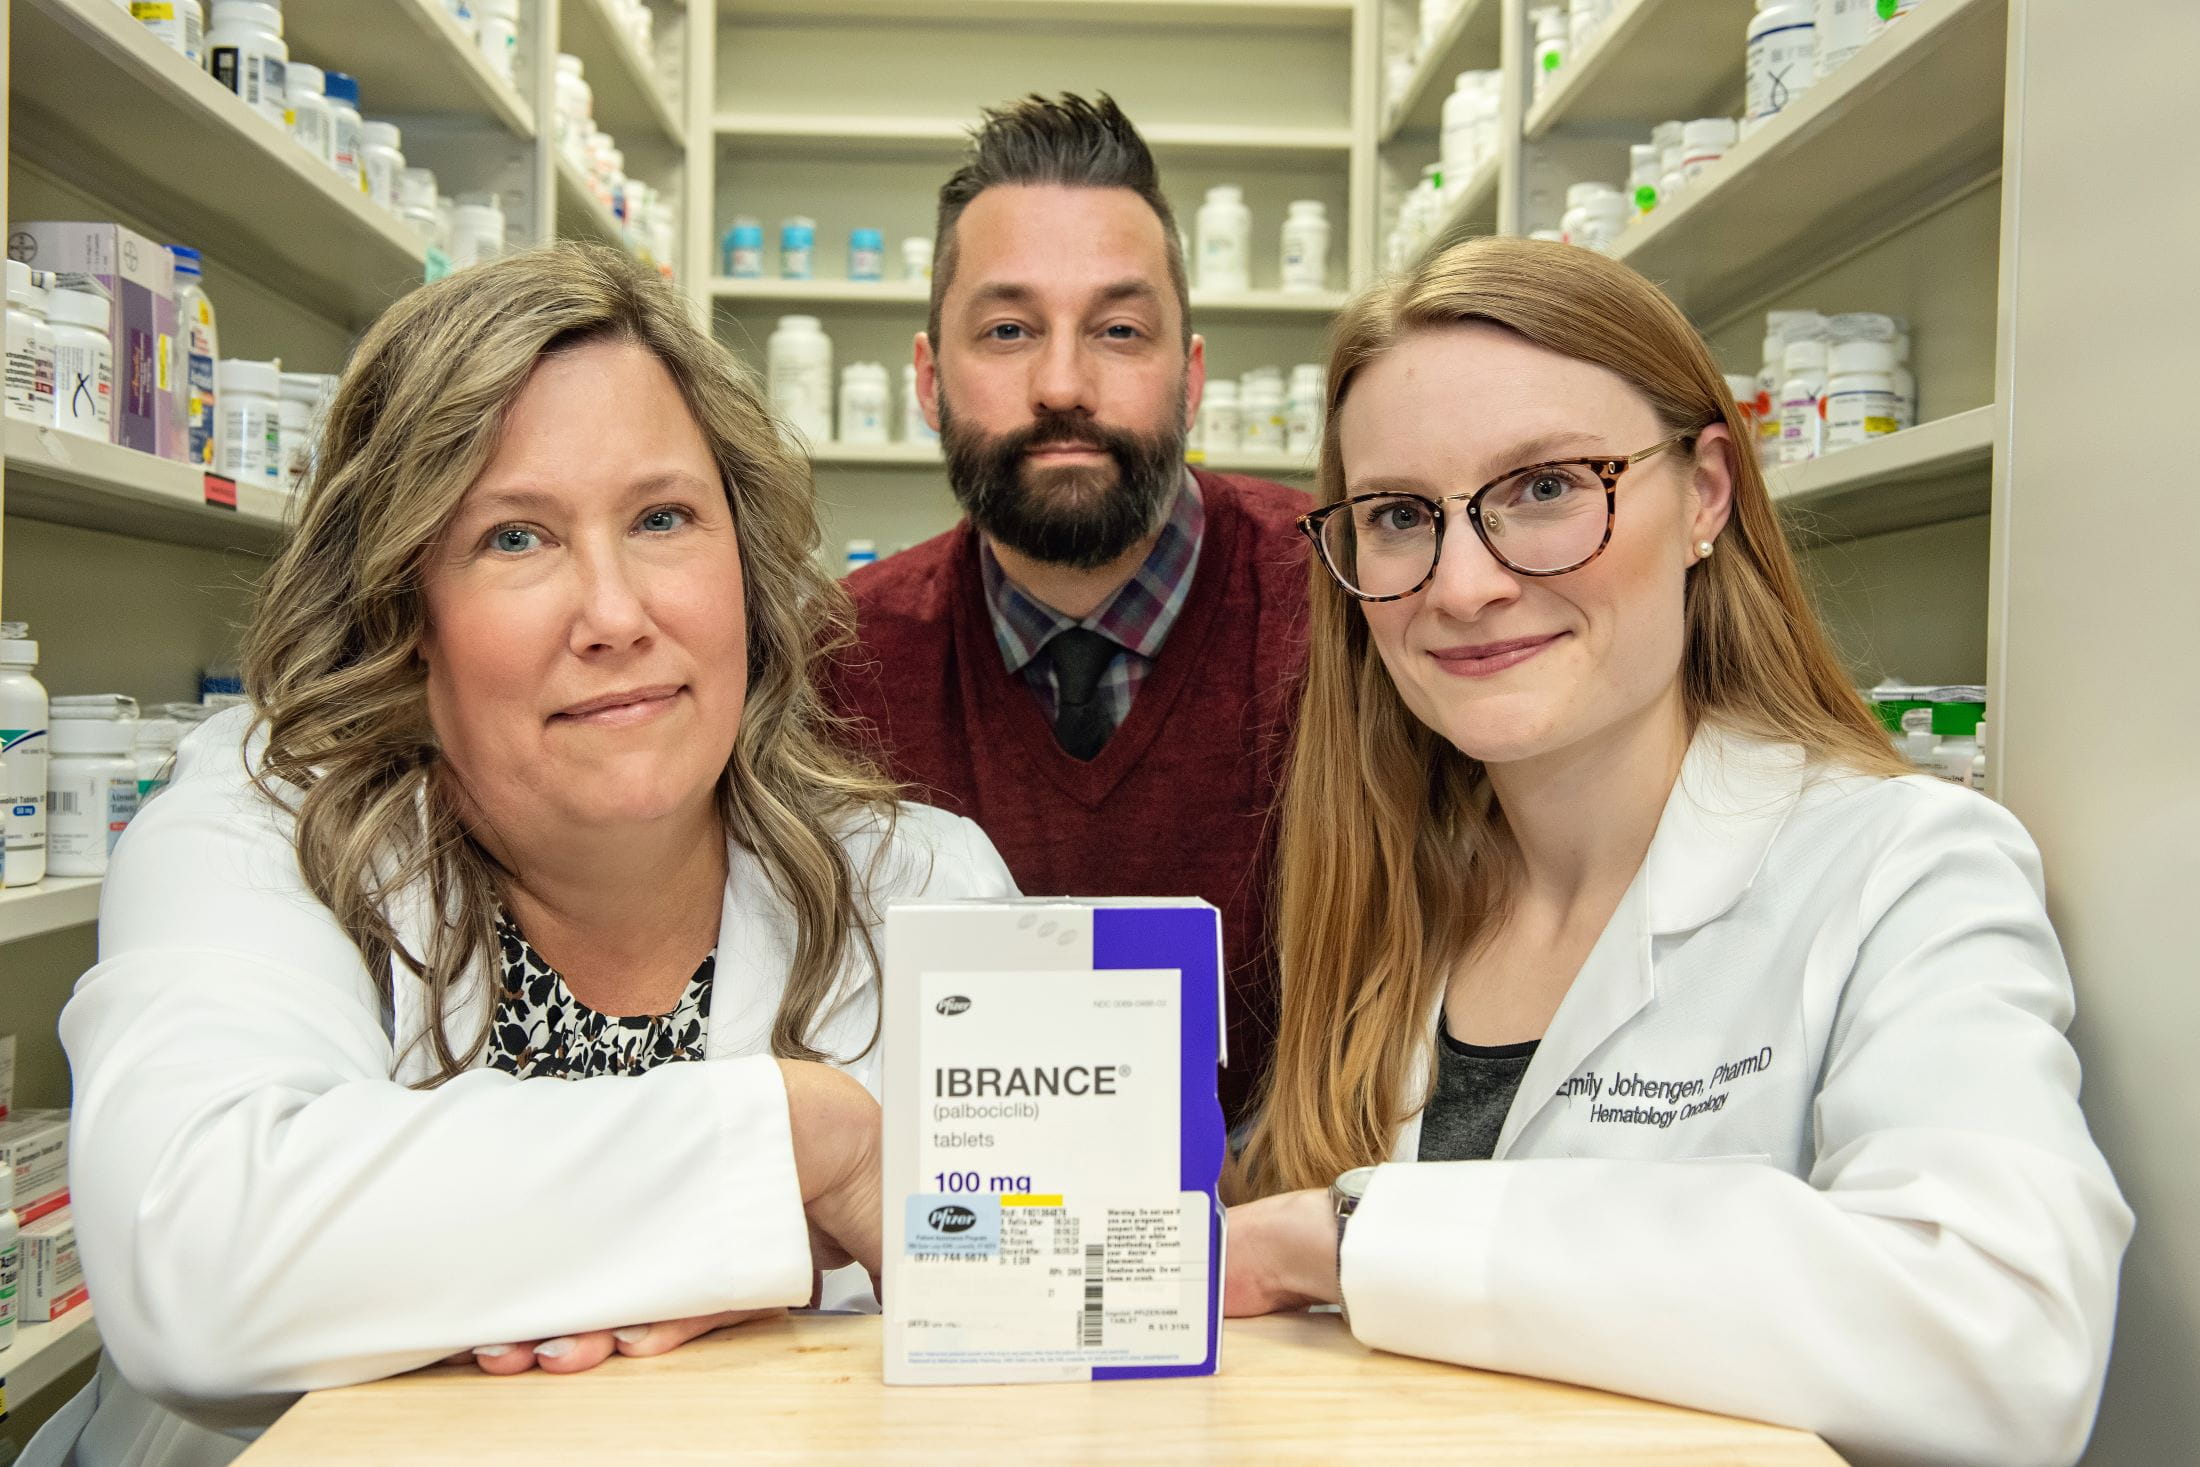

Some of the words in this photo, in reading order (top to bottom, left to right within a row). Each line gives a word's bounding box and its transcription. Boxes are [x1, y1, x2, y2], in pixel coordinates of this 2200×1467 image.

[936, 995, 972, 1016] Pfizer
[1608, 1071, 1705, 1105] Johengen,
[1709, 1046, 1772, 1090] PharmD
[933, 1102, 1040, 1122] (palbociclib)
[1590, 1103, 1677, 1129] Hematology
[1679, 1091, 1729, 1121] Oncology
[933, 1131, 995, 1149] tablets
[935, 1171, 980, 1193] 100
[989, 1174, 1032, 1194] mg
[929, 1205, 977, 1233] Pfizer
[914, 1252, 940, 1263] (877)
